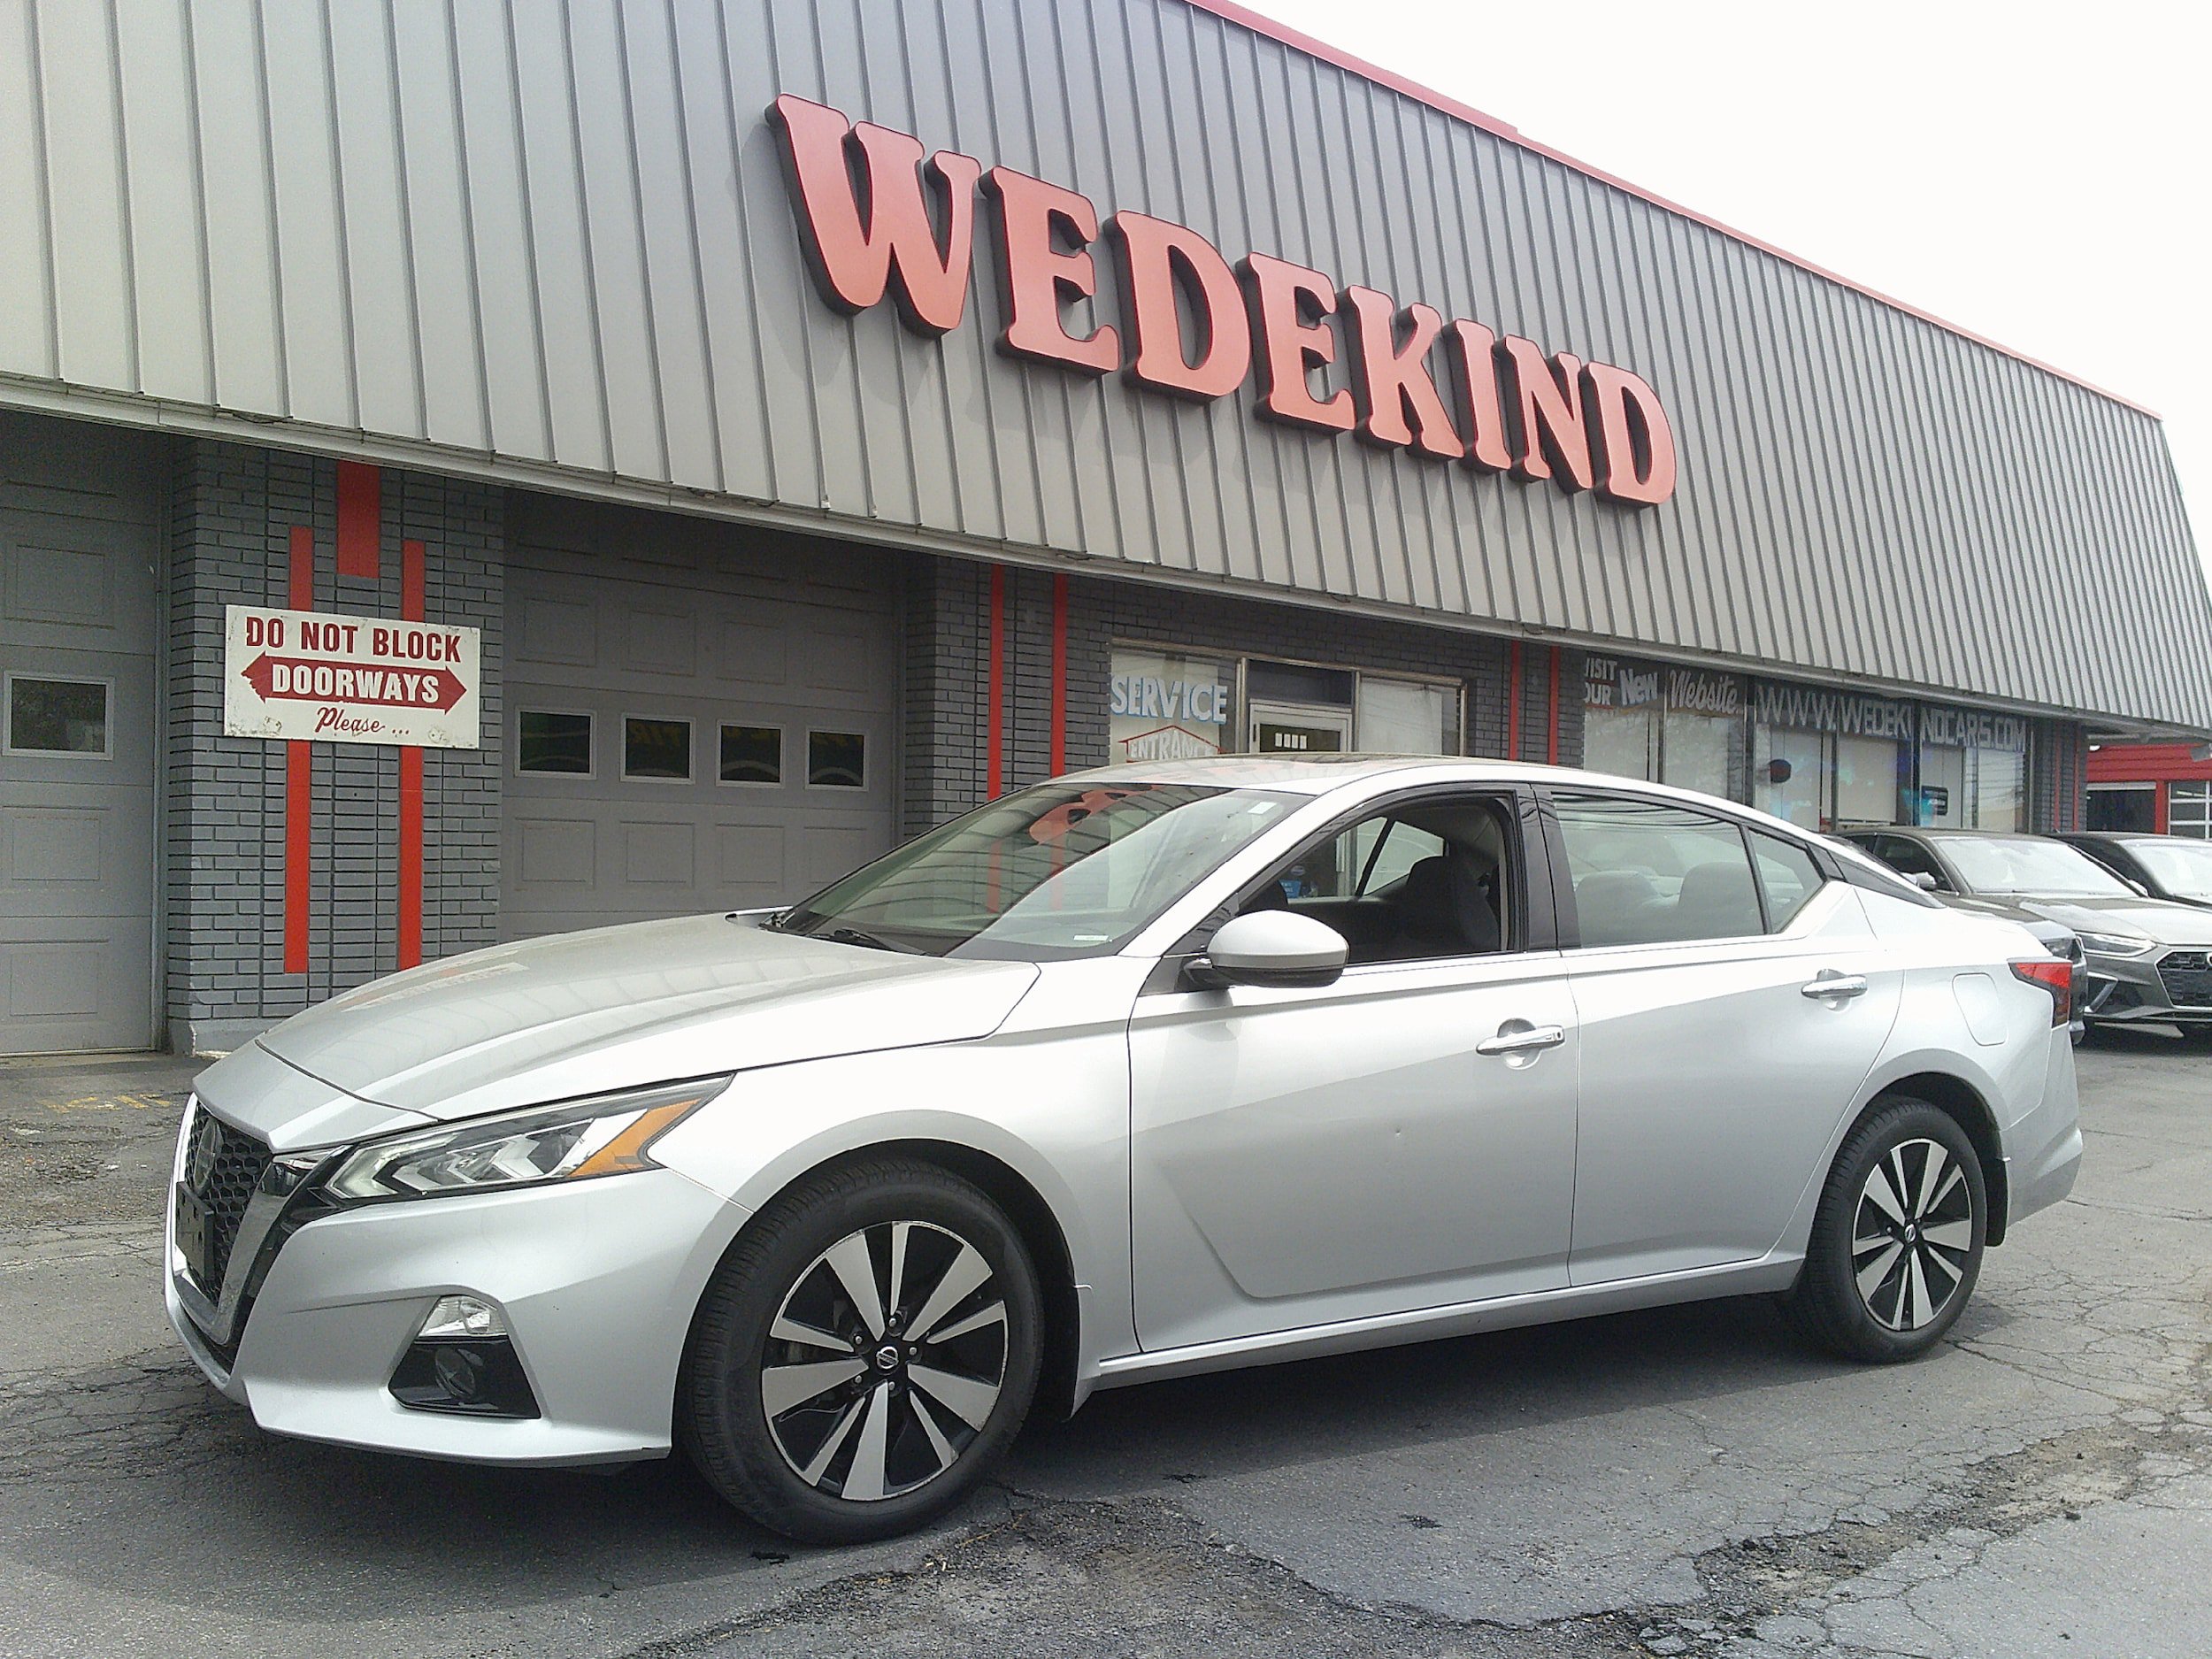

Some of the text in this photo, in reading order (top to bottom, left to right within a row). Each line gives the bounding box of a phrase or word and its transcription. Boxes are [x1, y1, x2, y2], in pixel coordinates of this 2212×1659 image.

[766, 93, 1677, 507] WEDEKIND
[246, 616, 462, 663] DO NOT BLOCK
[272, 664, 440, 703] DOORWAYS
[1110, 674, 1228, 725] SERVICE
[1619, 668, 1658, 706] New
[1669, 670, 1738, 714] Website
[314, 707, 386, 733] Please
